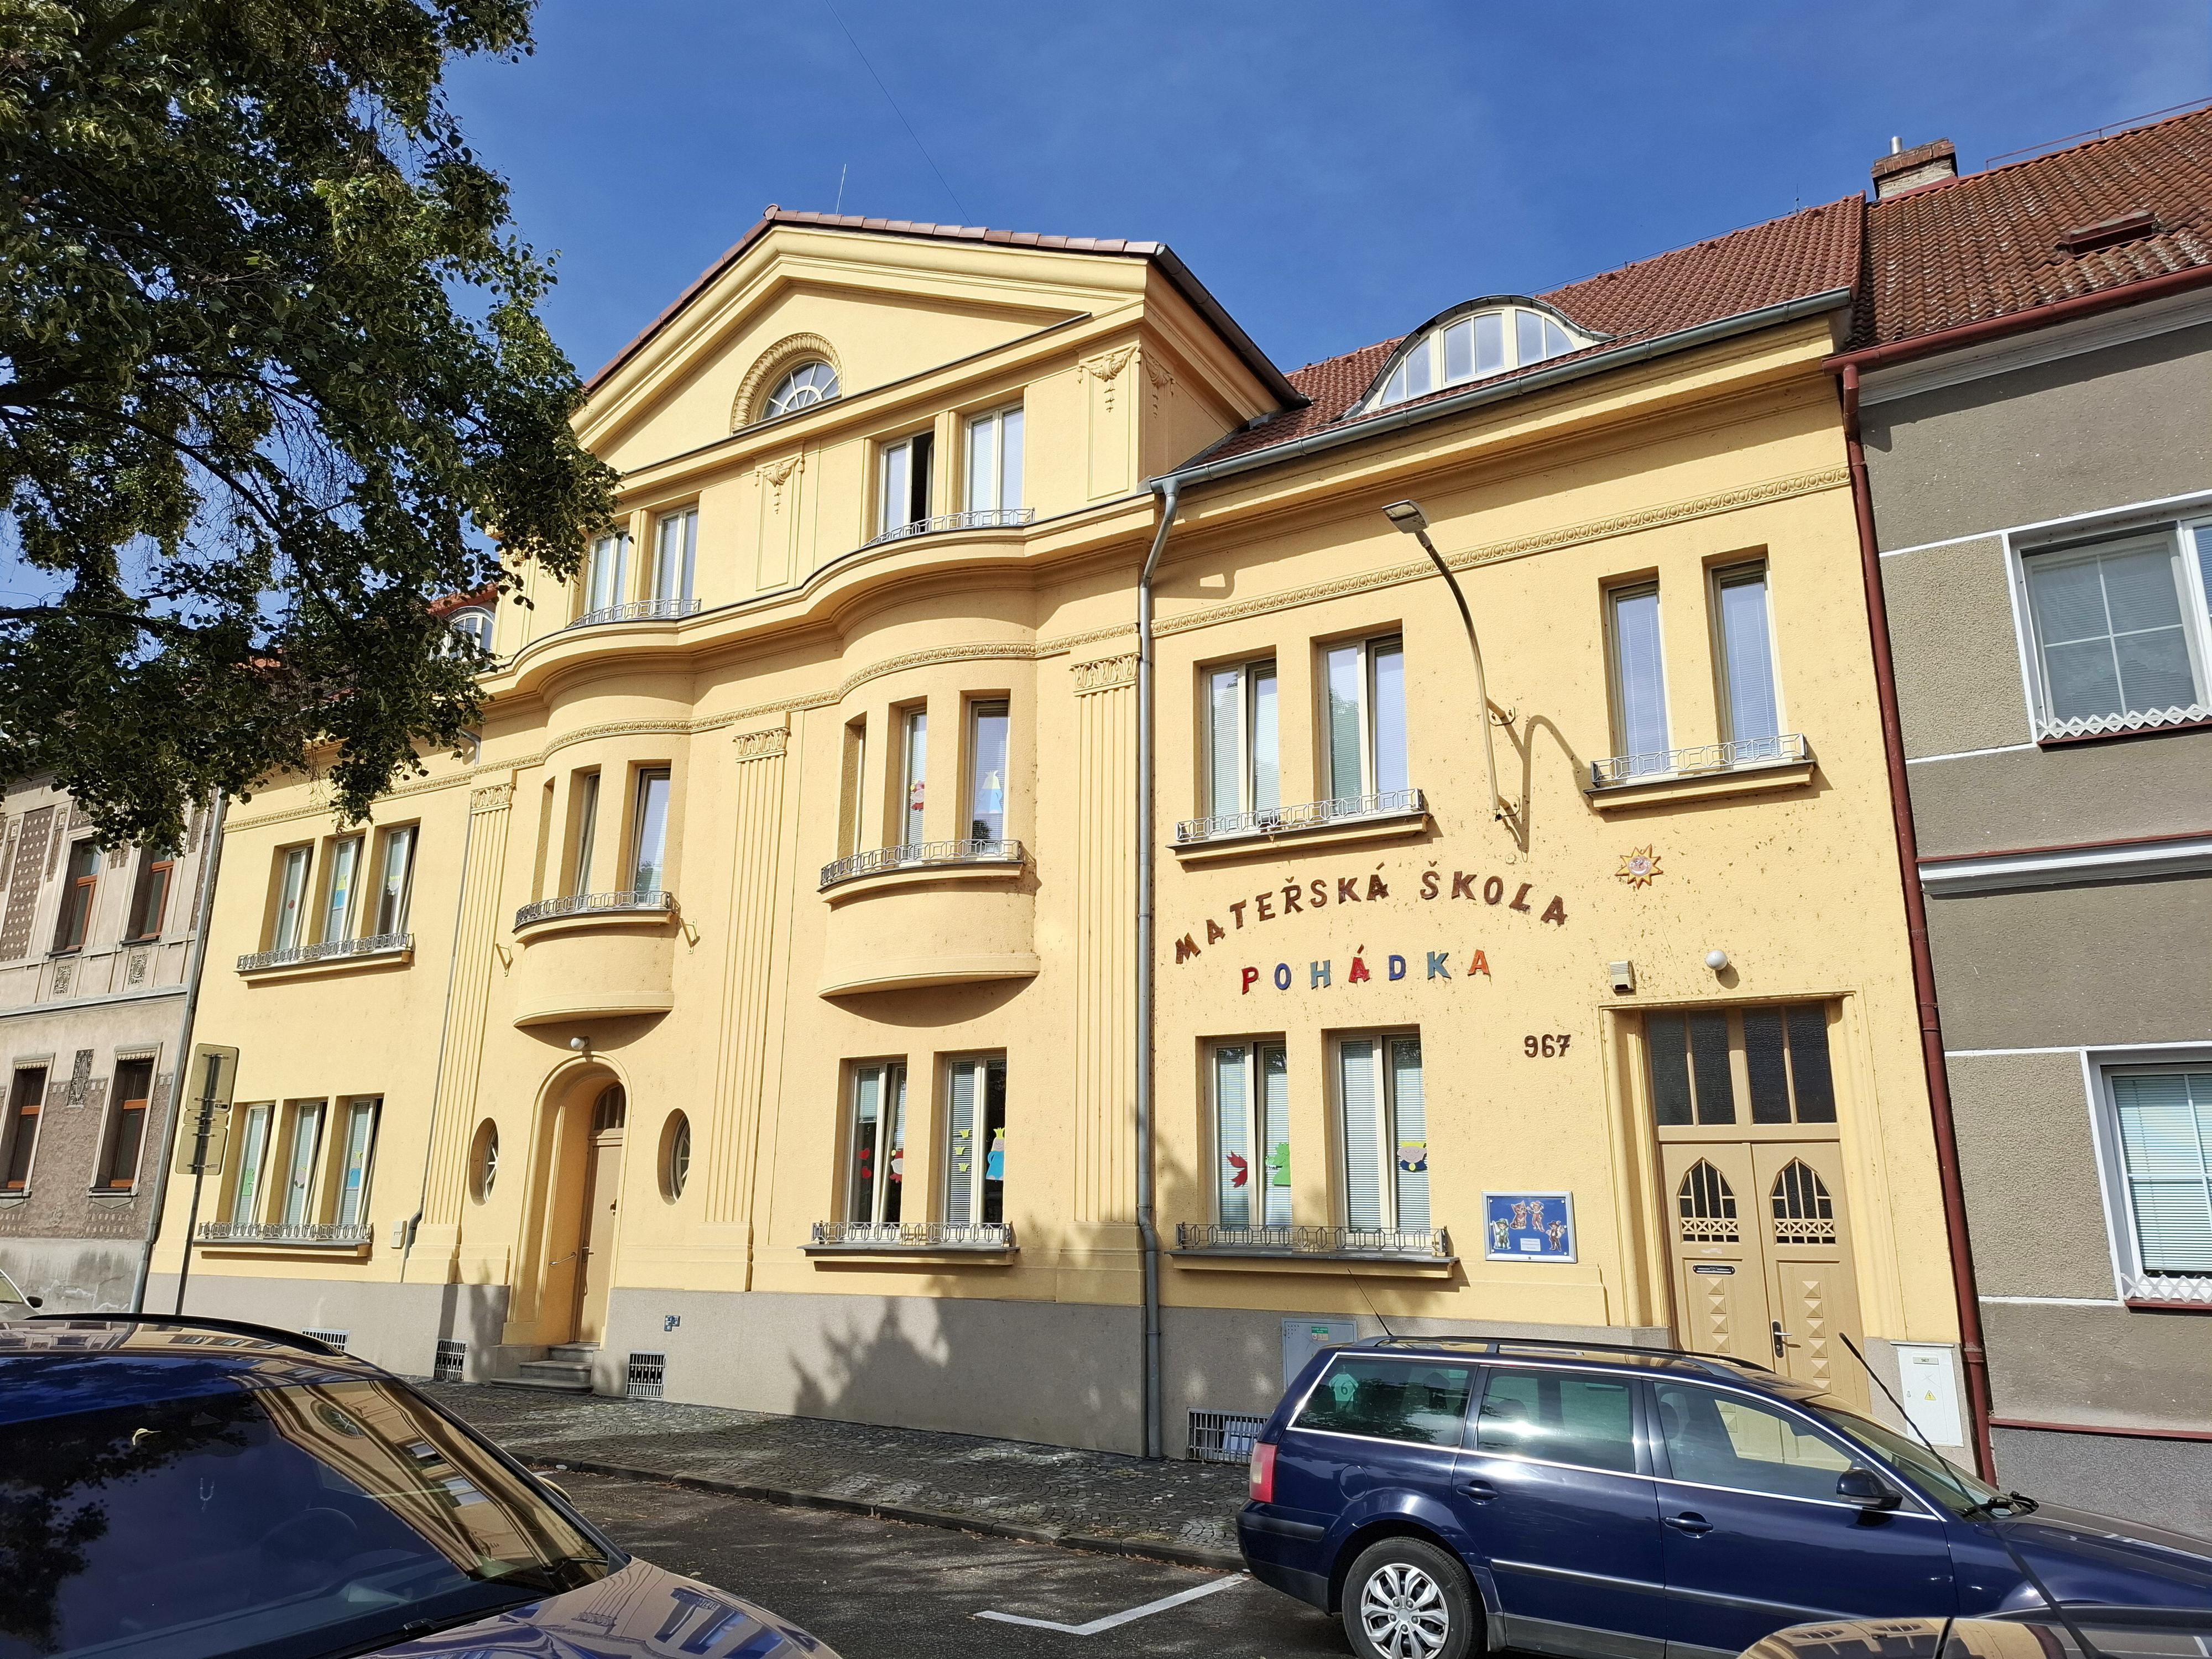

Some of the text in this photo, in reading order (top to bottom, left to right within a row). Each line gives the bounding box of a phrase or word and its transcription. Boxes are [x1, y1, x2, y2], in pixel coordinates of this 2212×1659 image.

[1175, 860, 1568, 964] MATEŘSKÁ ŠKOLA
[1241, 945, 1491, 994] POHÁDKA
[1524, 1034, 1571, 1058] 967
[1340, 1382, 1348, 1395] 6
